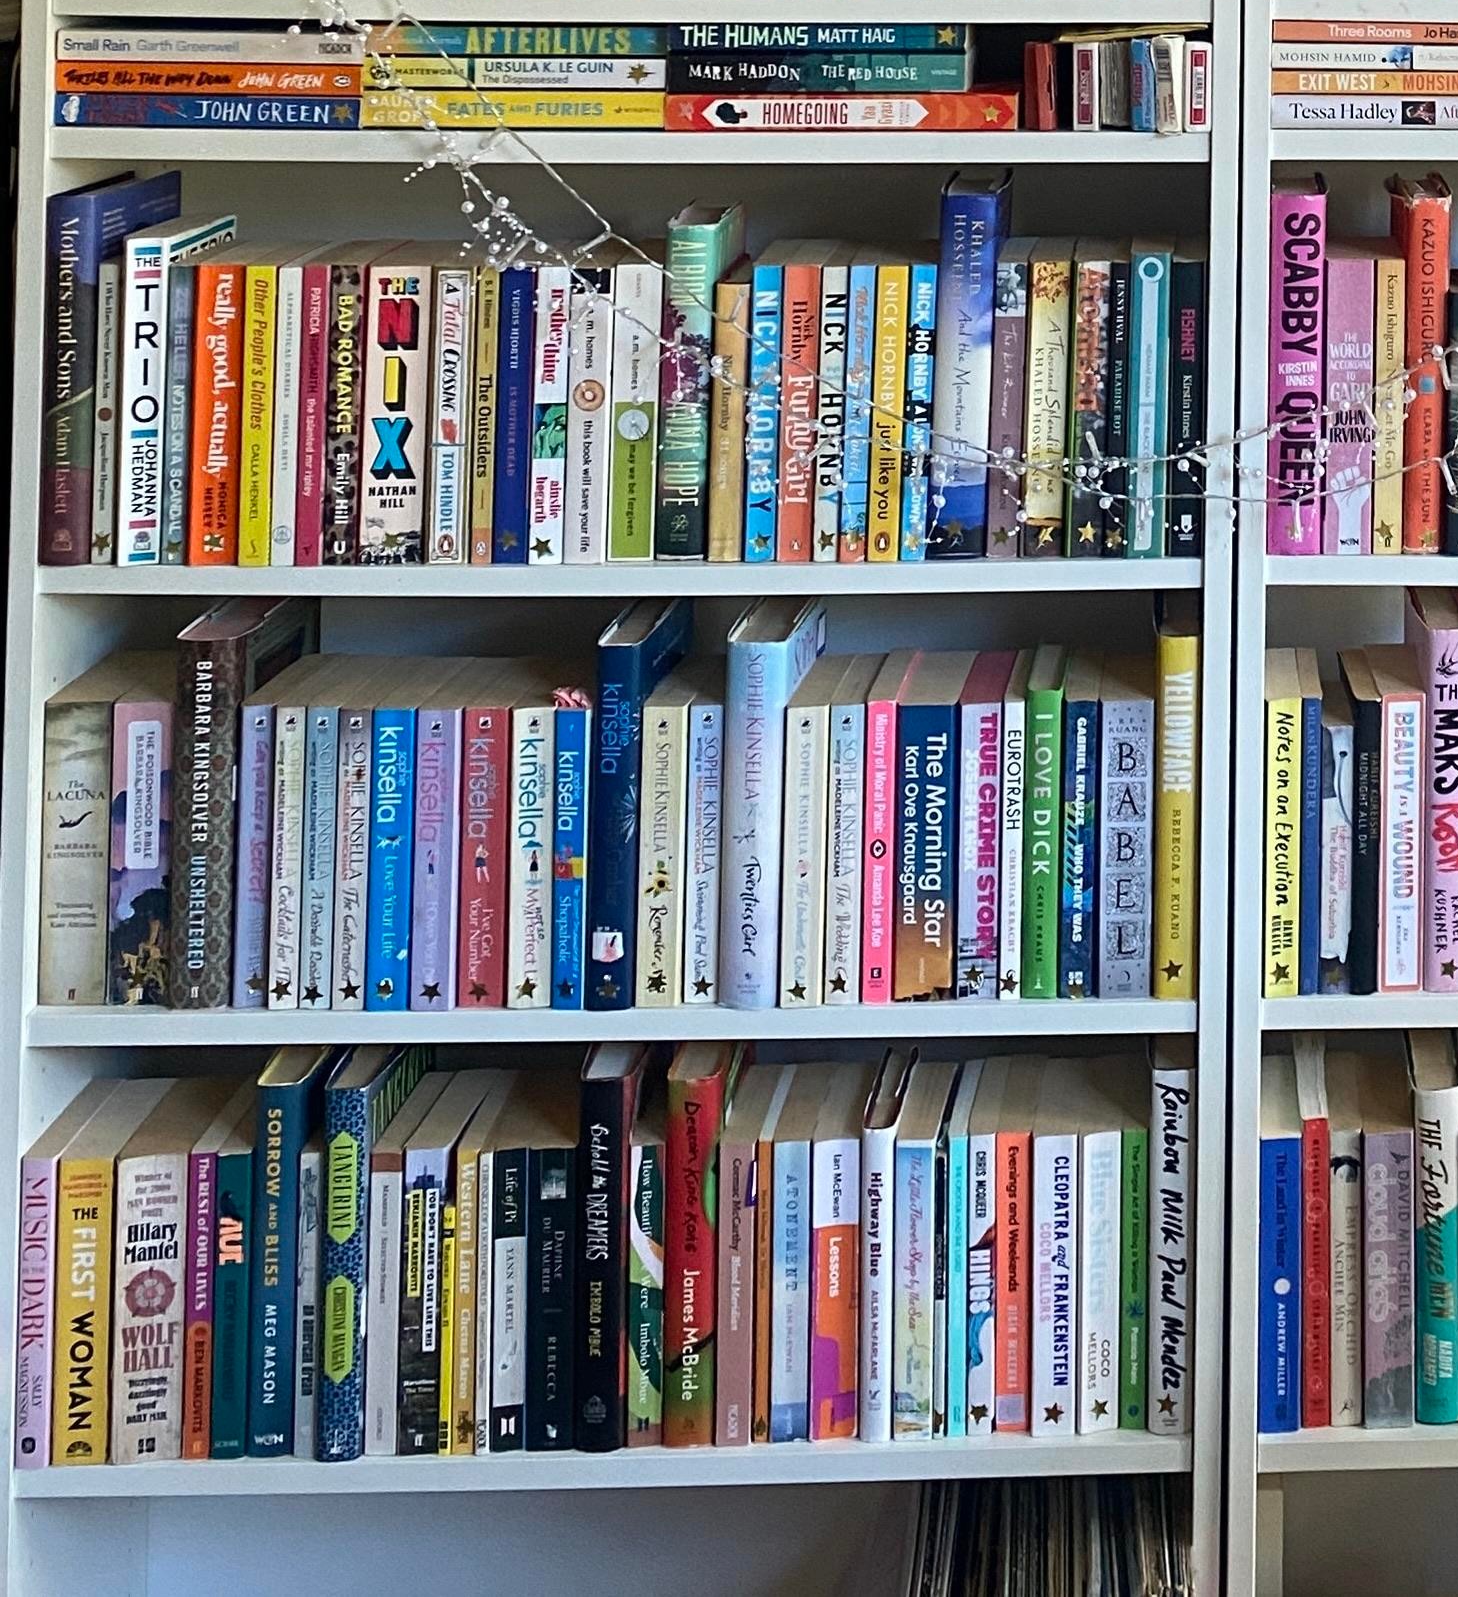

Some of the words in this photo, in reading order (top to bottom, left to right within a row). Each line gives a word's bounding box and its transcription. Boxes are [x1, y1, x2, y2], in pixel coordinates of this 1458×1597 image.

[679, 25, 719, 47] THE
[724, 25, 808, 47] HUMANS
[817, 27, 858, 43] MATT
[861, 27, 895, 44] HAIG
[194, 100, 252, 121] JOHN
[258, 101, 329, 124] GREEN
[762, 102, 848, 125] HOMEGOING
[1288, 102, 1335, 120] Tessa
[1339, 103, 1398, 124] Hadley
[337, 295, 352, 333] BAD
[1281, 213, 1321, 355] SCABBY
[337, 339, 352, 433] ROMANCE
[478, 374, 492, 402] The
[476, 406, 491, 478] Outsiders
[130, 445, 144, 513] HEDMAN
[145, 440, 157, 516] JOHANNA
[194, 661, 213, 735] BARBARA
[905, 746, 919, 779] Karl
[925, 732, 947, 778] The
[1006, 730, 1021, 830] EUROTRASH
[191, 742, 211, 842] KINGSOLVER
[903, 783, 917, 817] Ove
[919, 785, 945, 890] Morning
[899, 822, 917, 924] Knausgaard
[188, 856, 207, 970] UNSHELTERED
[924, 899, 945, 947] Star
[1054, 1156, 1069, 1240] CLEOPATRA
[72, 1227, 96, 1301] FIRST
[1052, 1245, 1069, 1269] and
[265, 1304, 277, 1337] MEG
[682, 1268, 699, 1323] James
[1053, 1275, 1068, 1386] FRANKENSTEIN
[68, 1310, 93, 1431] WOMAN
[262, 1345, 276, 1404] MASON
[682, 1327, 699, 1401] McBride
